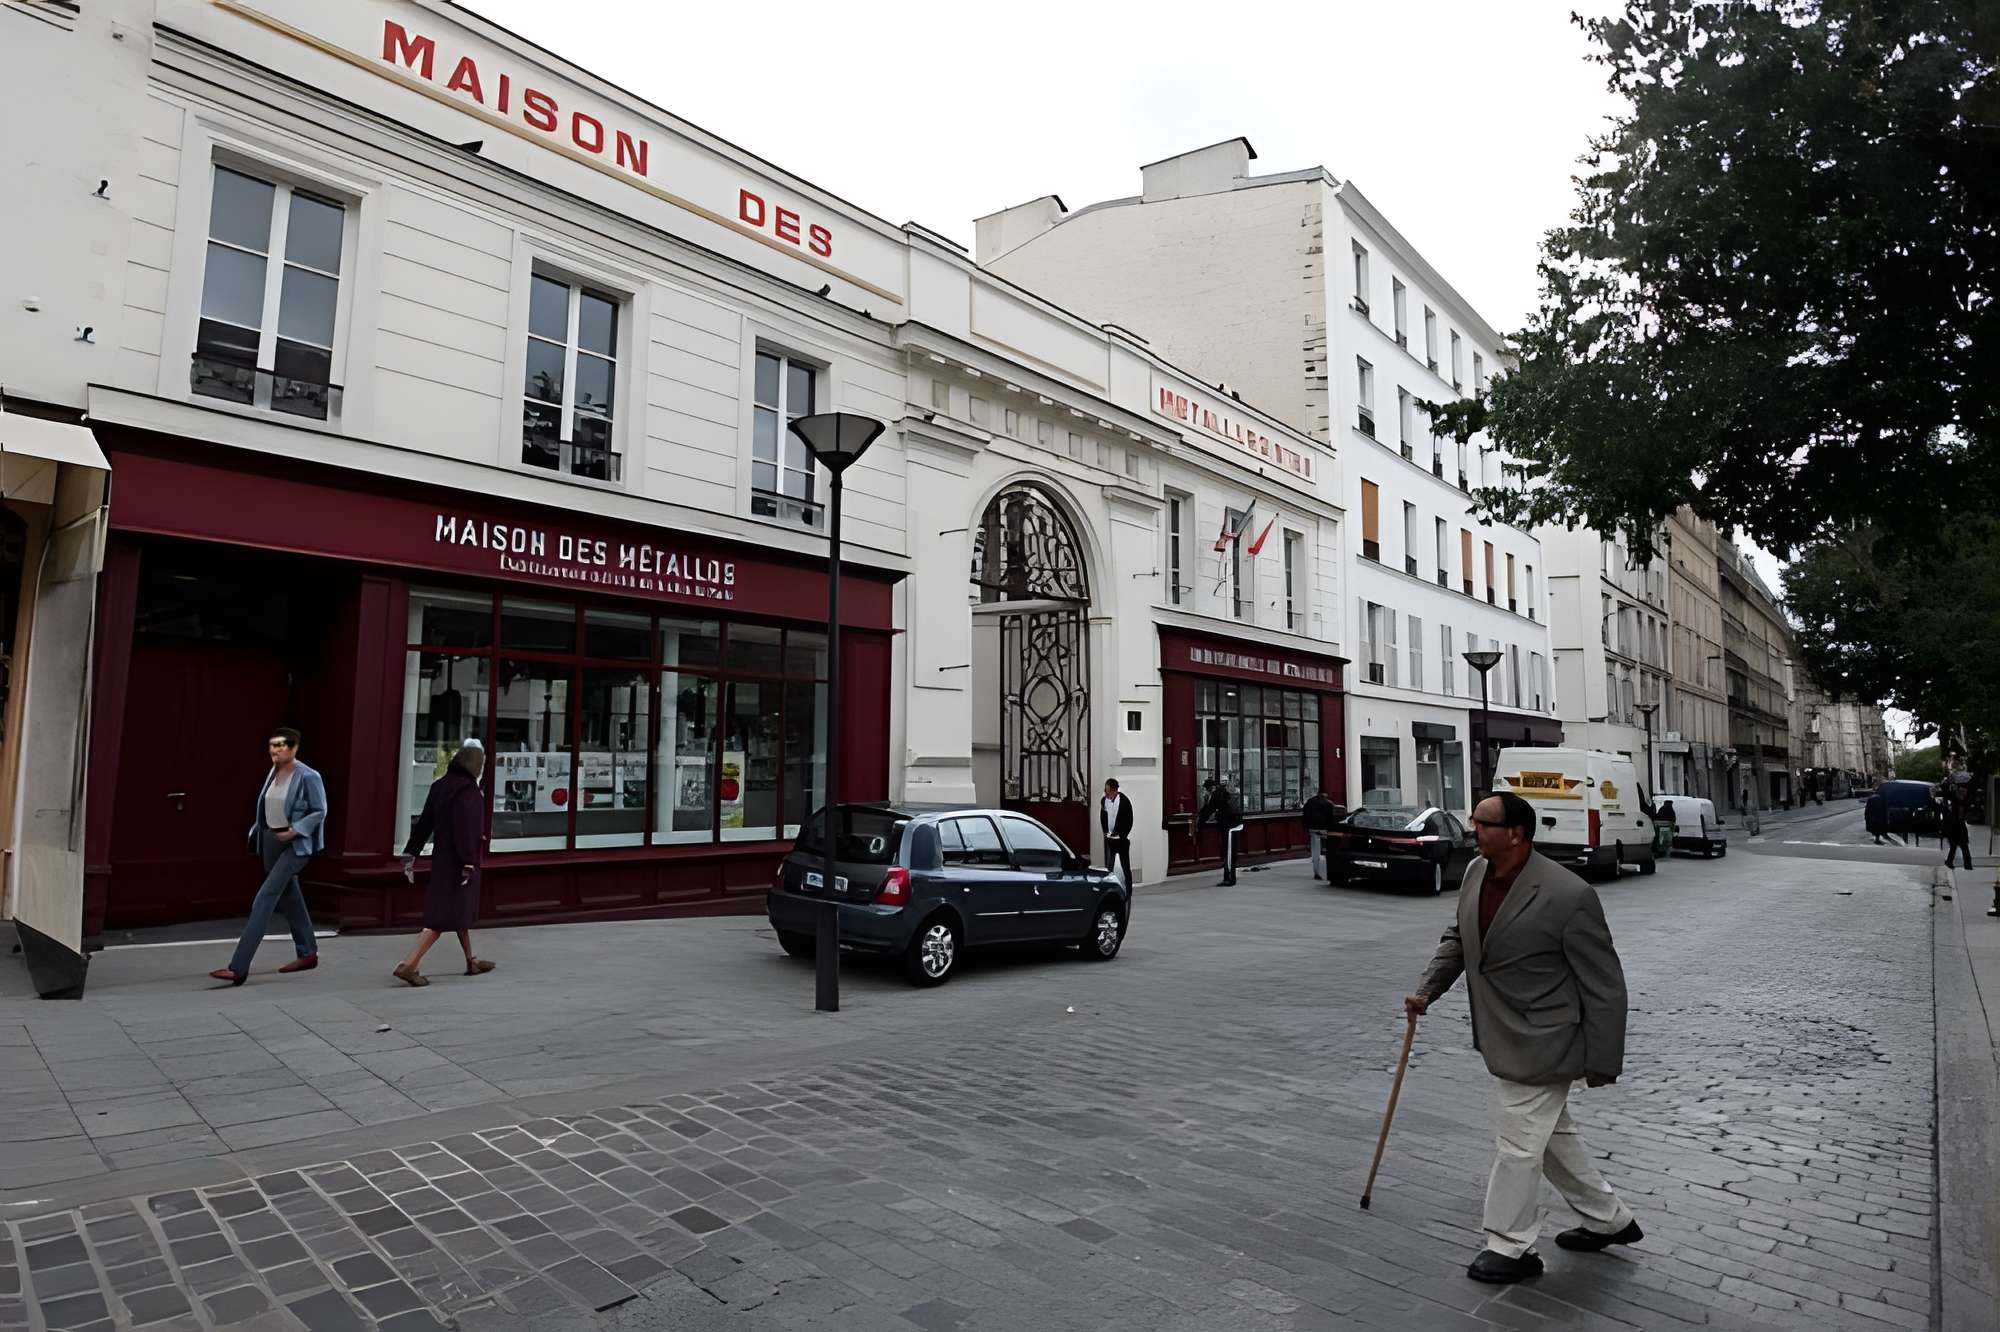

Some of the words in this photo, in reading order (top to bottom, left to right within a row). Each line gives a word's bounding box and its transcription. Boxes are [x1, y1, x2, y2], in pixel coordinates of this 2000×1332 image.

[383, 19, 649, 177] MAISON
[739, 189, 833, 257] DES
[435, 514, 545, 556] MAISON
[559, 535, 607, 566] DES
